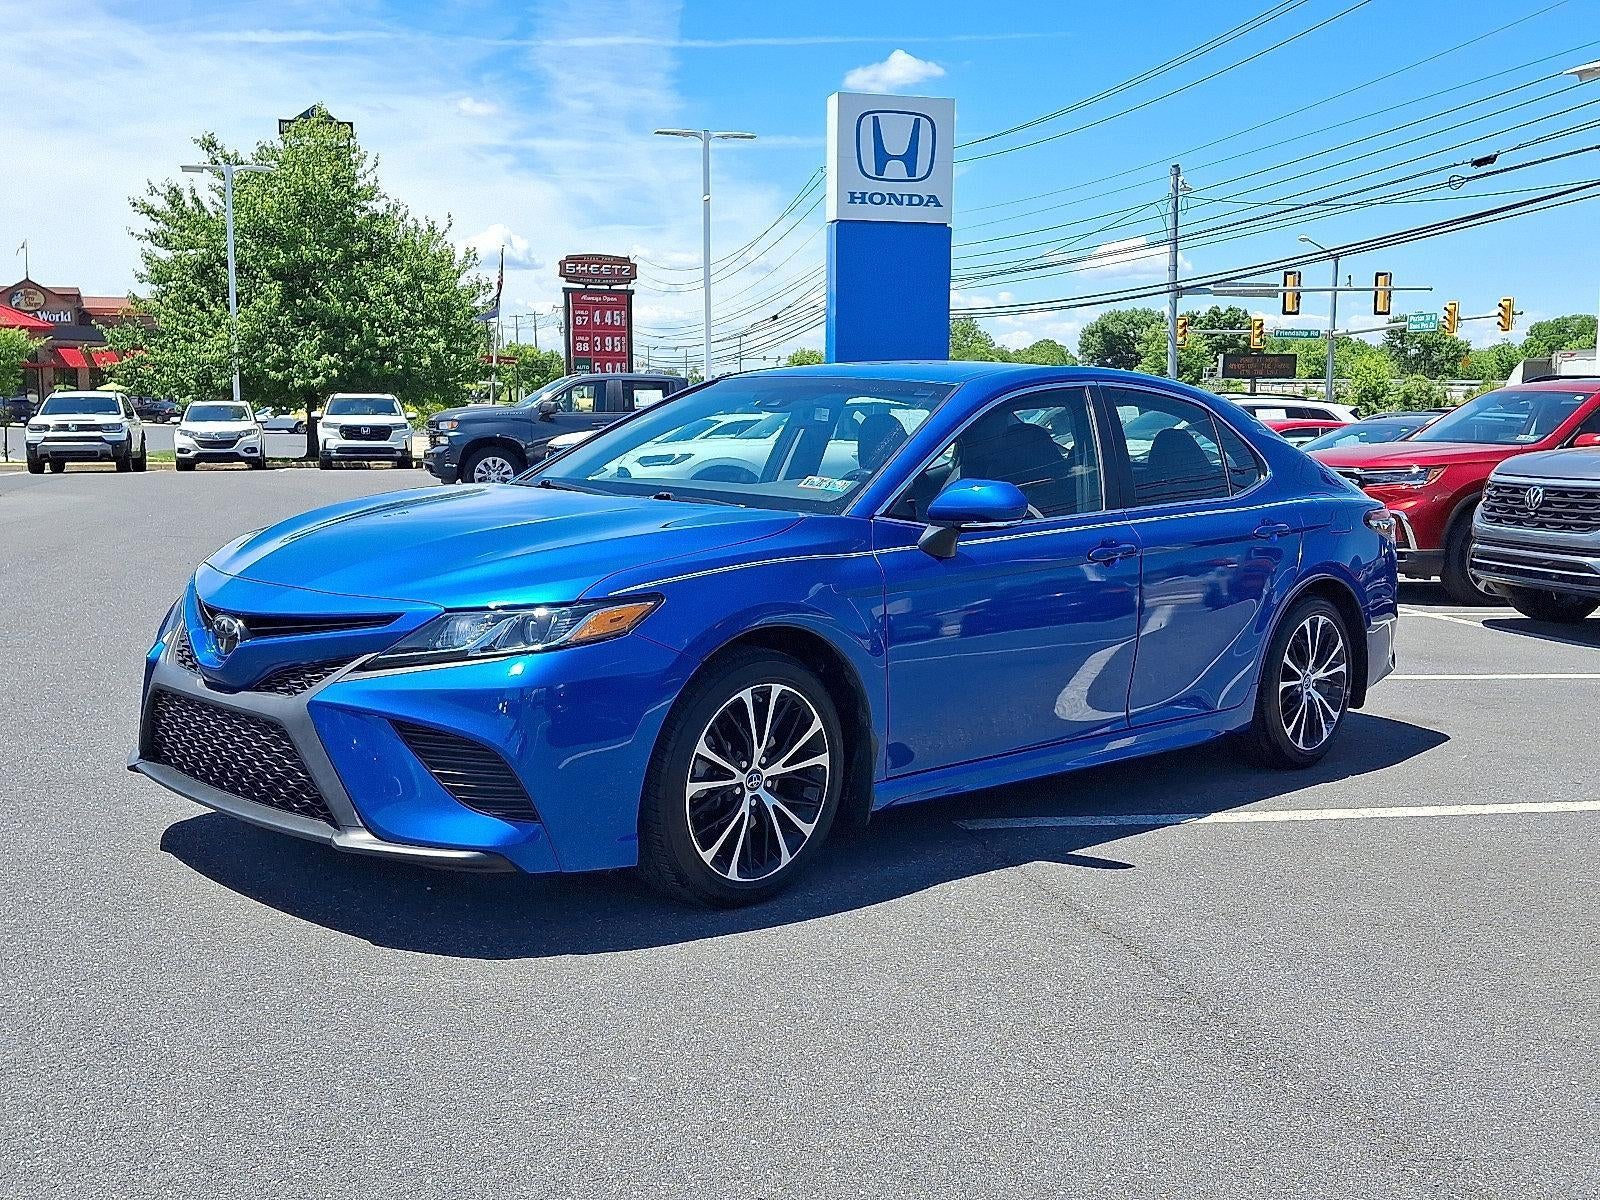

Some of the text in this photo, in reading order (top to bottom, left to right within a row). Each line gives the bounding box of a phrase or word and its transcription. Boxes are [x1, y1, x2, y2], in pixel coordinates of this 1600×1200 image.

[848, 191, 943, 207] HONDA
[565, 263, 631, 276] SHEETZ
[37, 311, 71, 322] World
[575, 316, 589, 325] 87
[1275, 329, 1308, 337] Friendship
[576, 342, 589, 351] 88
